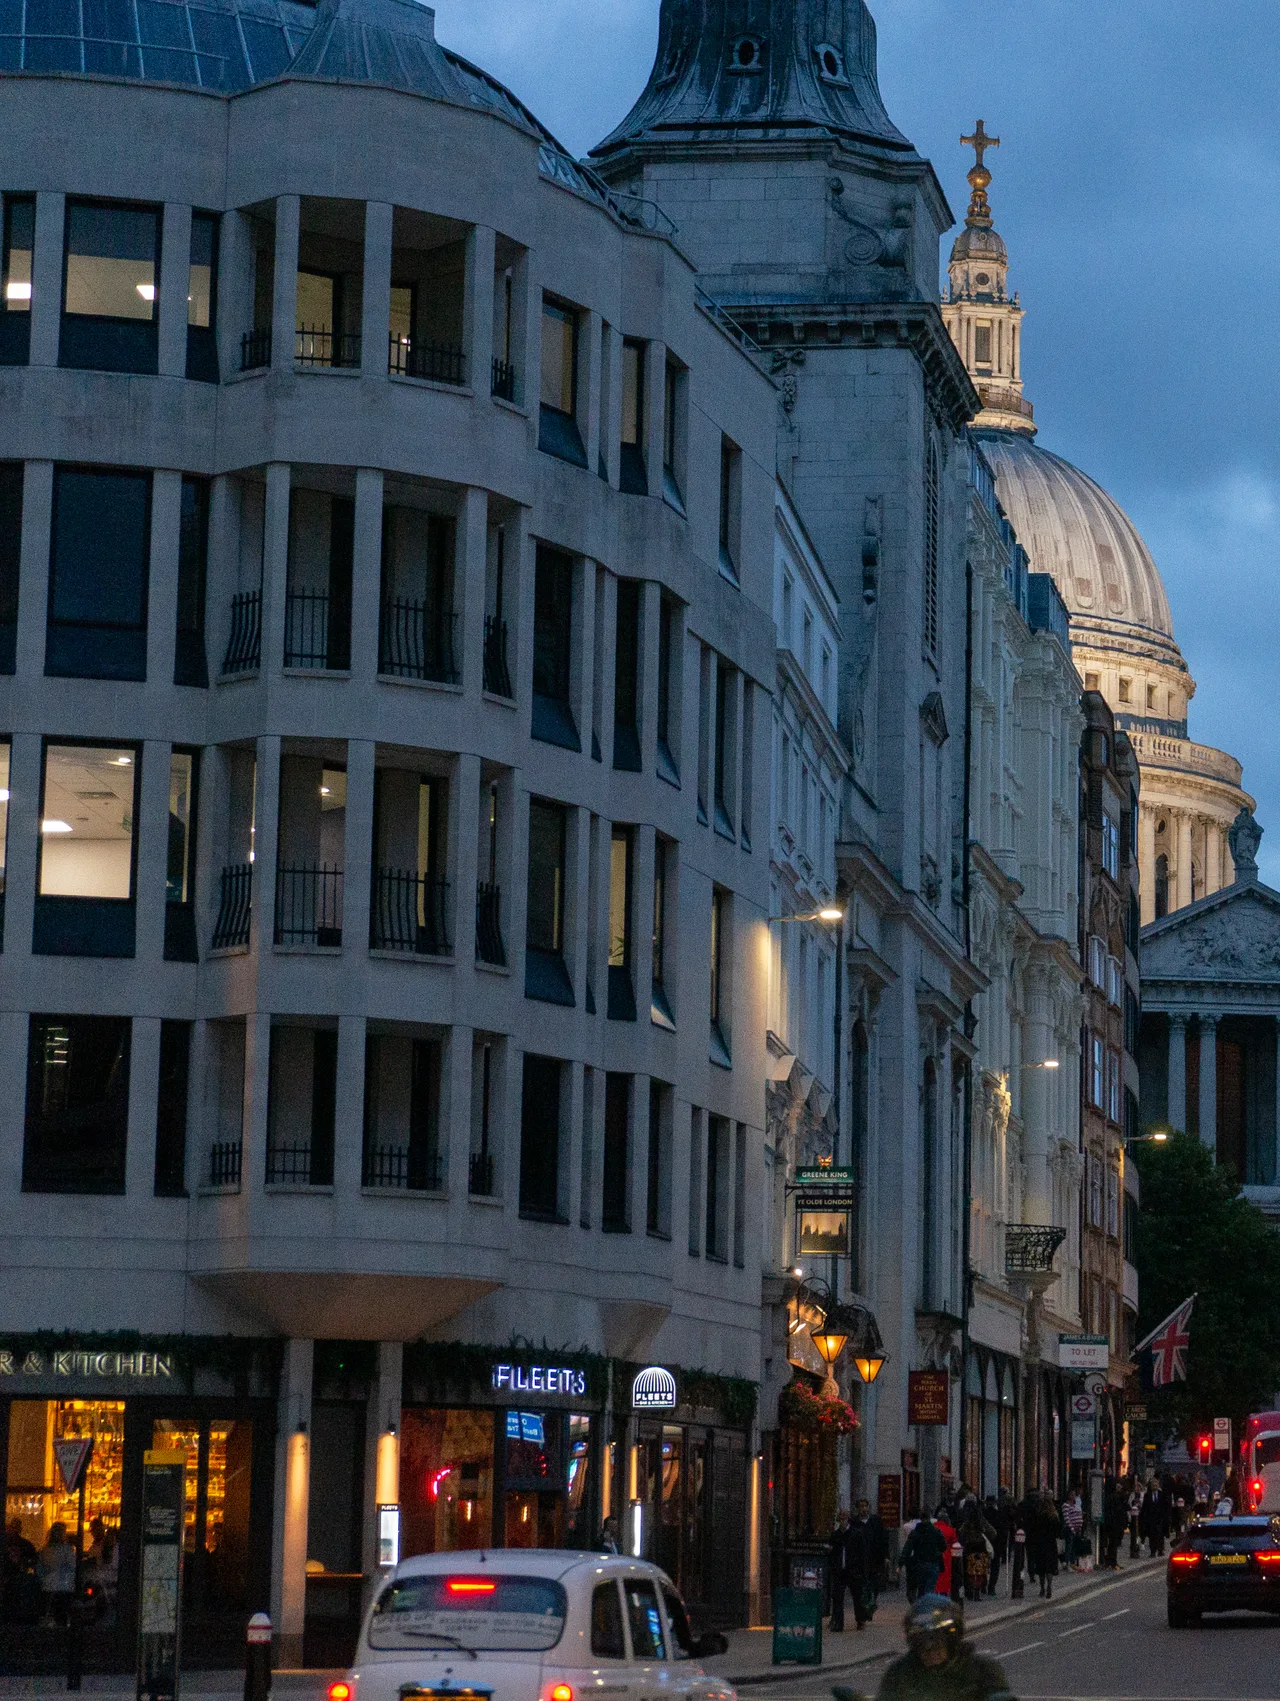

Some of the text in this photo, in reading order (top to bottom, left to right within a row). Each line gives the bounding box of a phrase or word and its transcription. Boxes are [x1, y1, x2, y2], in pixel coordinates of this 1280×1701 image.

[24, 1351, 42, 1374] &
[54, 1351, 171, 1376] KITCHEN
[493, 1366, 586, 1396] FLEETS
[636, 1393, 673, 1401] FLEETS
[60, 1446, 80, 1457] GIVE
